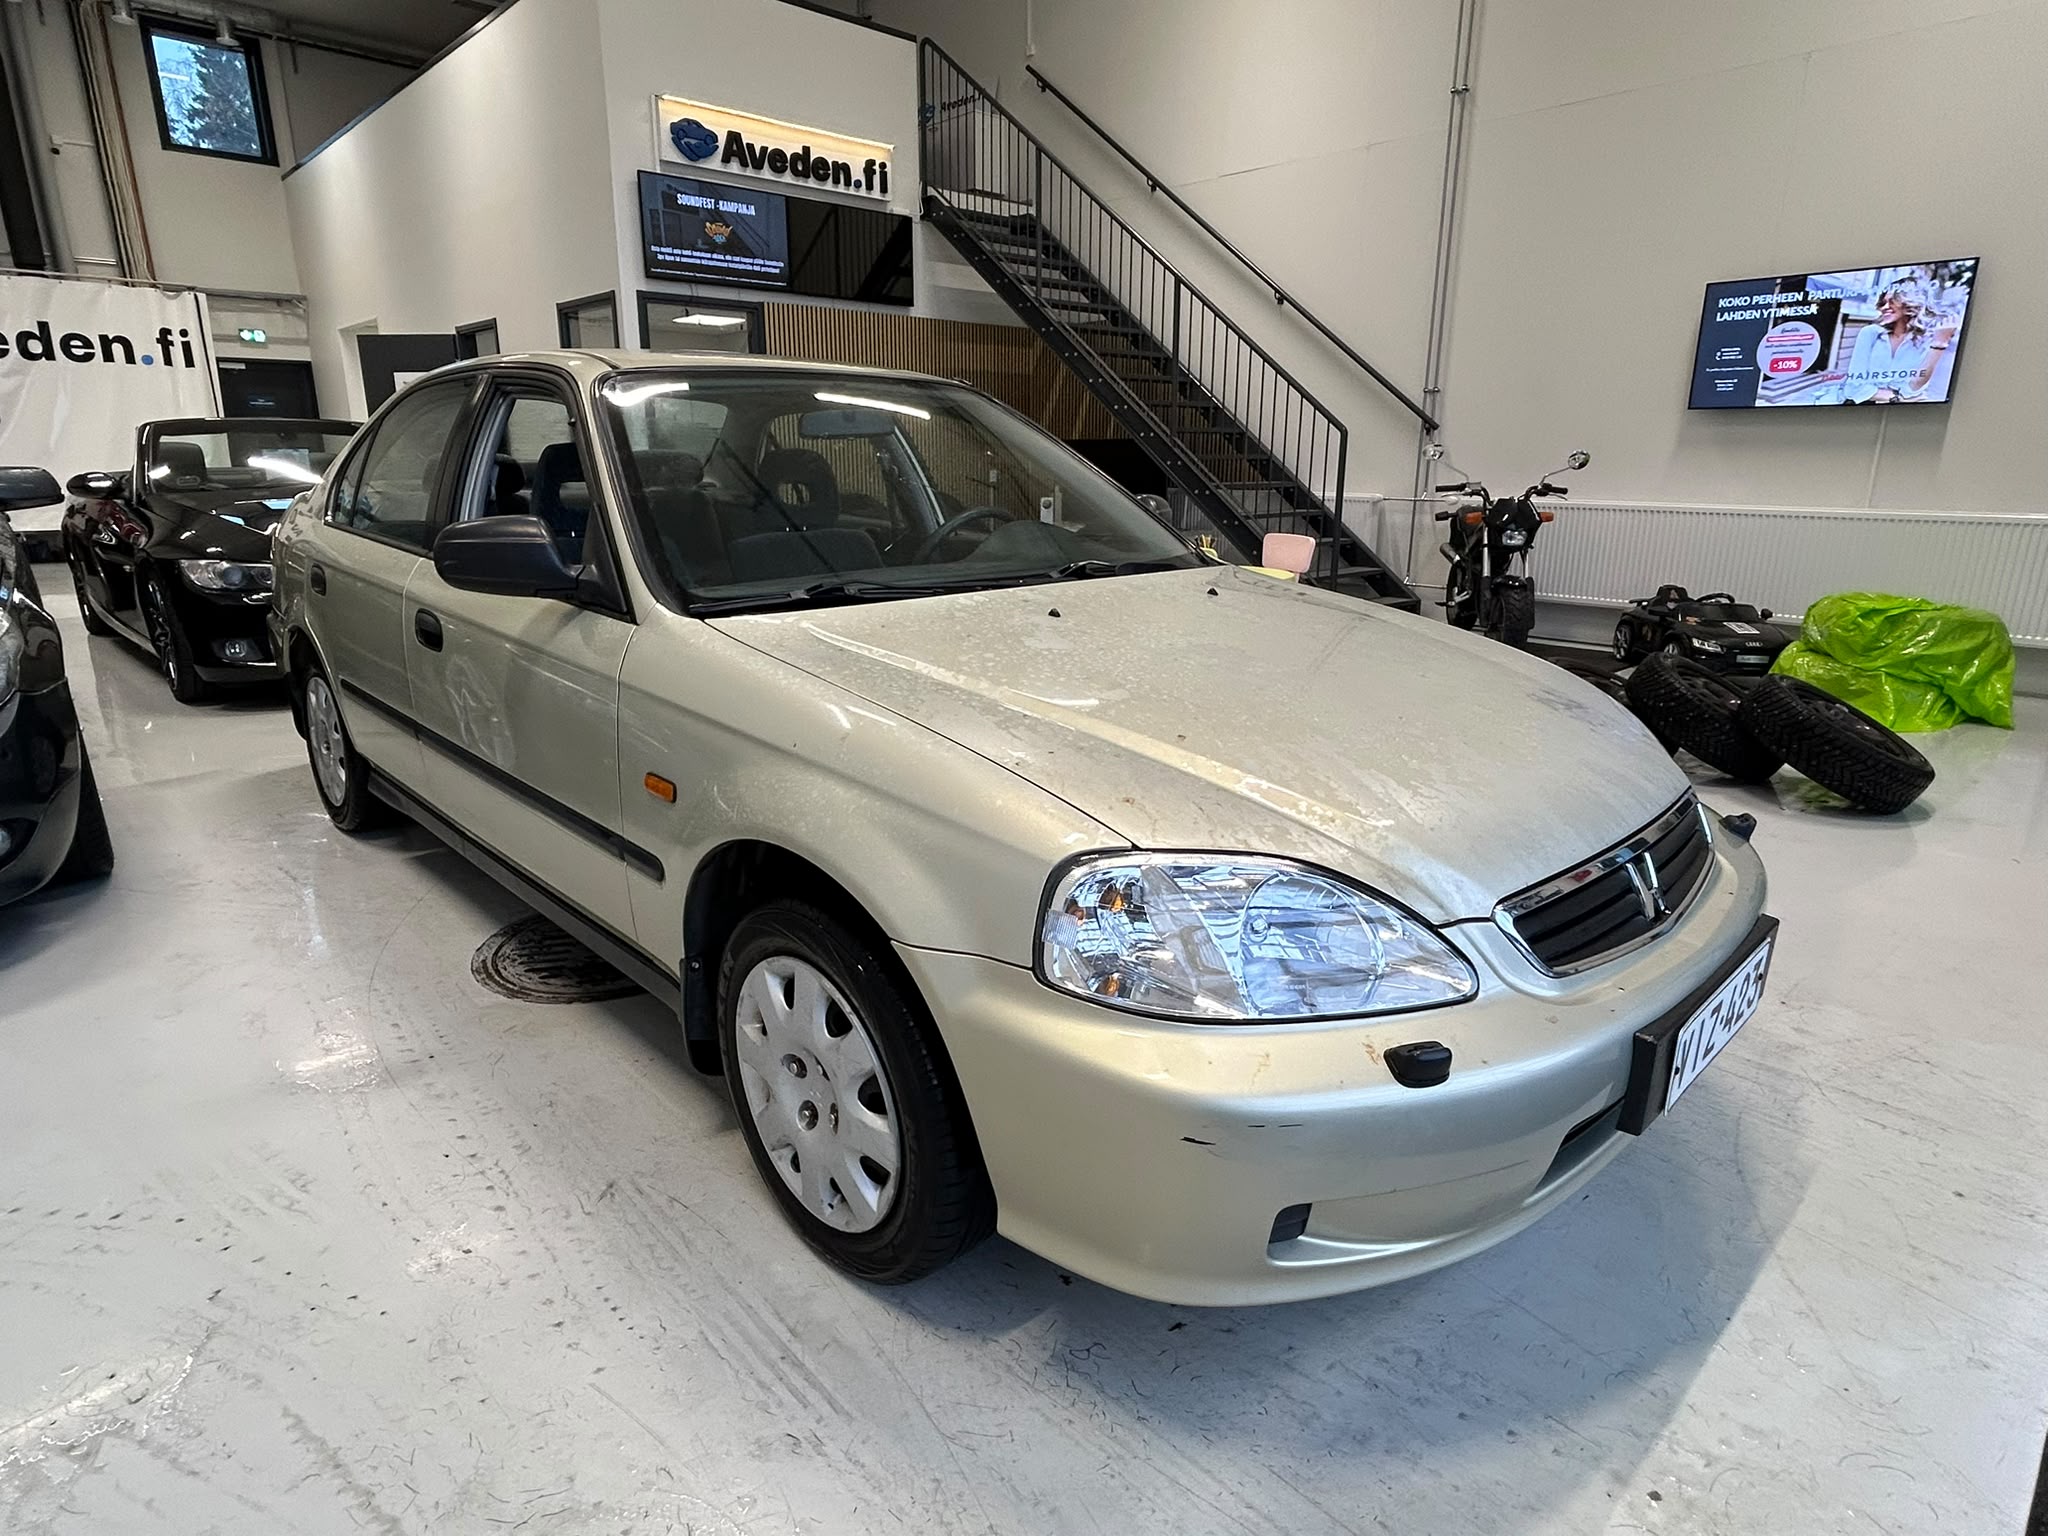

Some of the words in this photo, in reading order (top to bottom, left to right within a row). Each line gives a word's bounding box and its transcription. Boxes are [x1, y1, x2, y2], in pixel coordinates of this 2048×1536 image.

[721, 130, 888, 194] Aveden.fi
[676, 193, 715, 210] SOUNDFEST
[716, 199, 756, 216] -KAMPANJA
[1718, 296, 1750, 308] KOKO
[1751, 291, 1804, 306] PERHEEN
[1716, 308, 1760, 322] LAHDEN
[0, 320, 196, 369] den.fi
[1773, 359, 1798, 369] -10%
